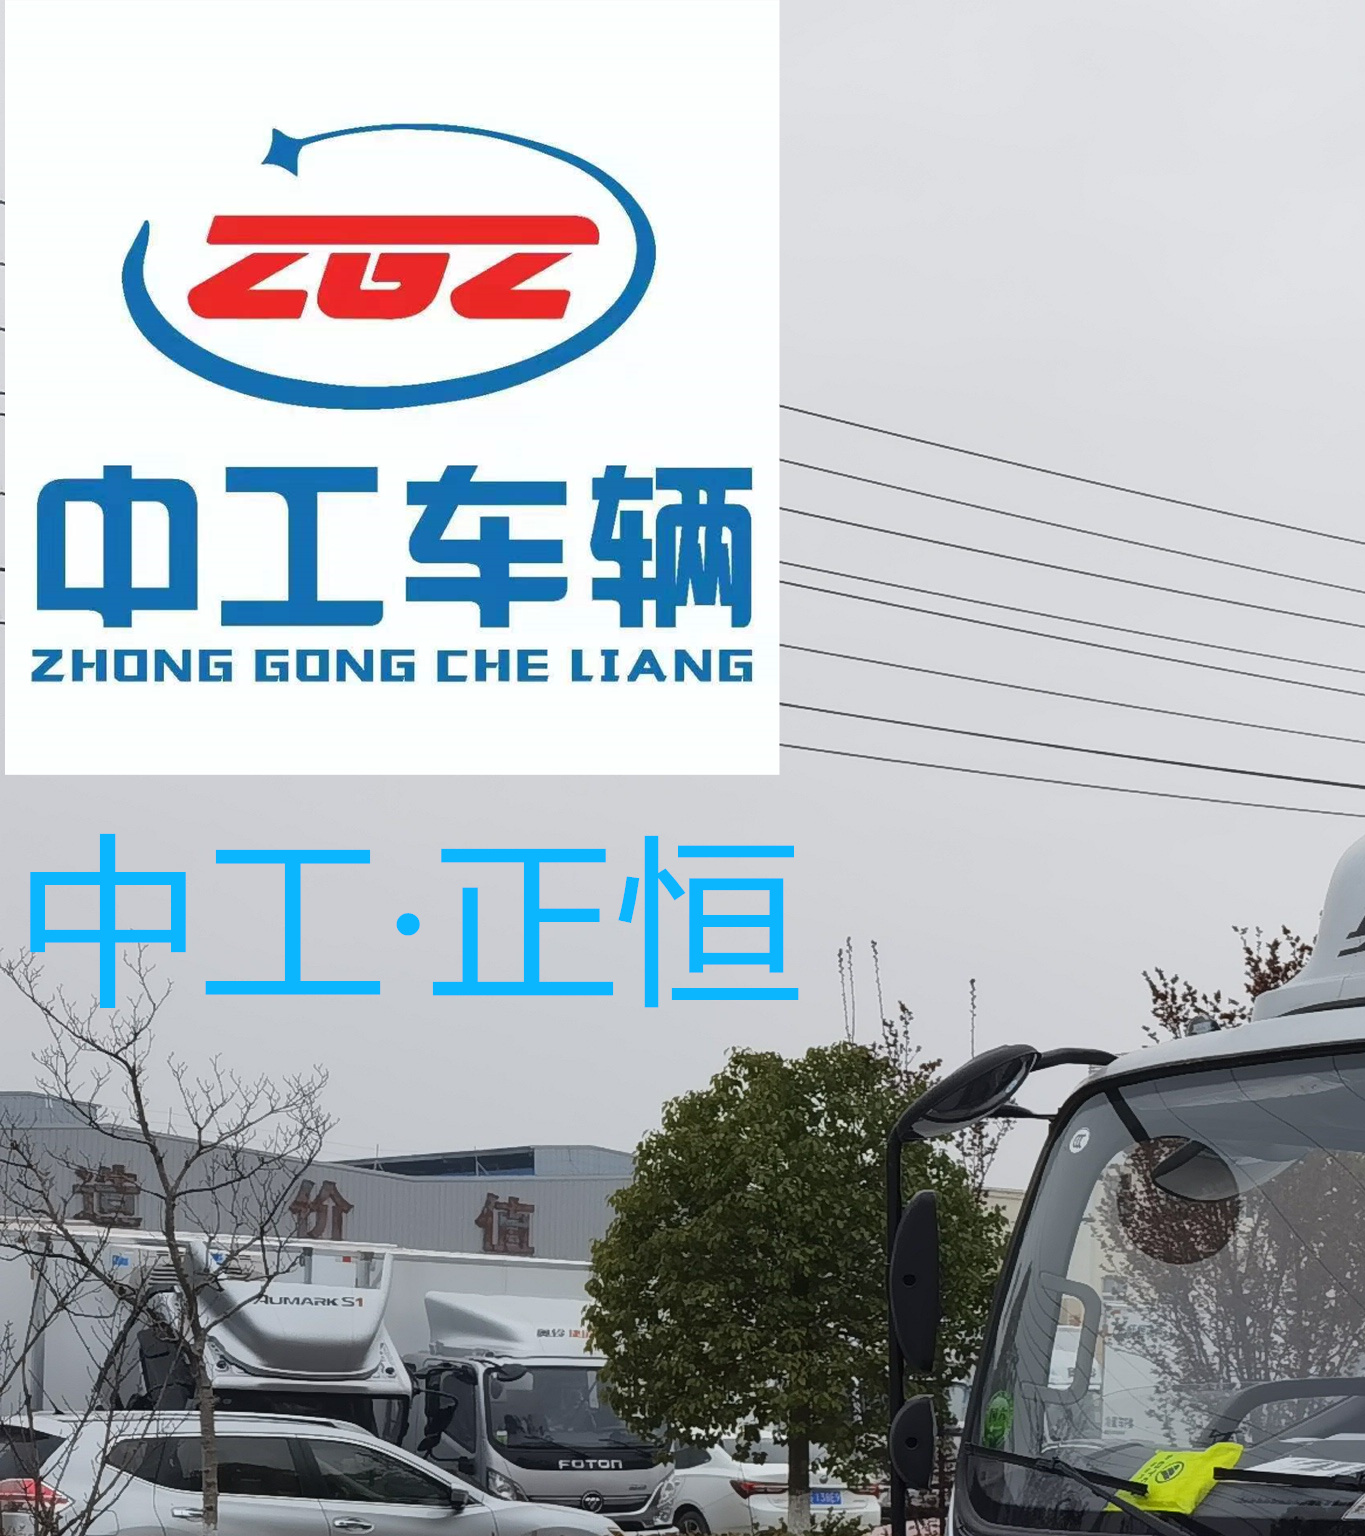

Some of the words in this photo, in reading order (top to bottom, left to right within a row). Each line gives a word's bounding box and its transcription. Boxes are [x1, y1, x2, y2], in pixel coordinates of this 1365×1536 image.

[253, 1295, 339, 1308] AUMARK
[341, 1296, 364, 1308] S1
[558, 1459, 623, 1470] FOTON
